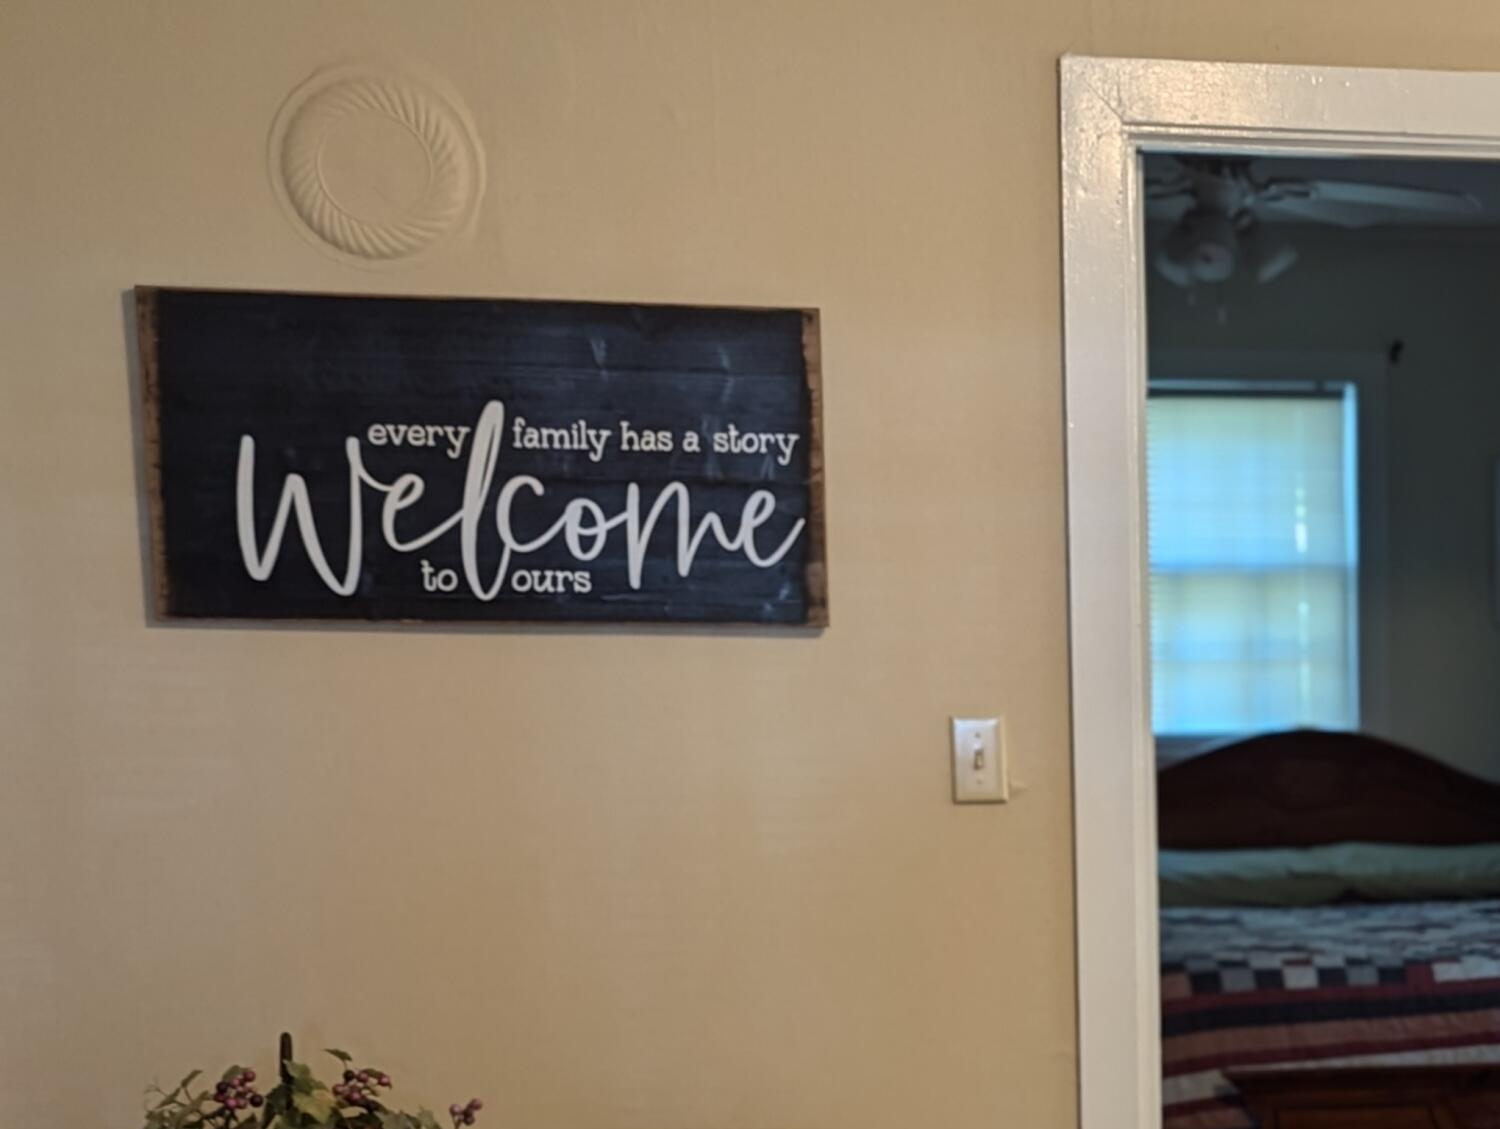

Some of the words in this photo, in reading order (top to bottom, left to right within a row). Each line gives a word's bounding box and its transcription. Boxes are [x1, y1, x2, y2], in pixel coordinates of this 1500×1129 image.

[368, 422, 471, 459] every
[513, 418, 611, 462] family
[621, 421, 673, 452] has
[682, 429, 701, 454] a
[713, 428, 799, 466] story
[237, 399, 805, 601] Welcome
[421, 559, 458, 593] to
[511, 567, 592, 594] ours
